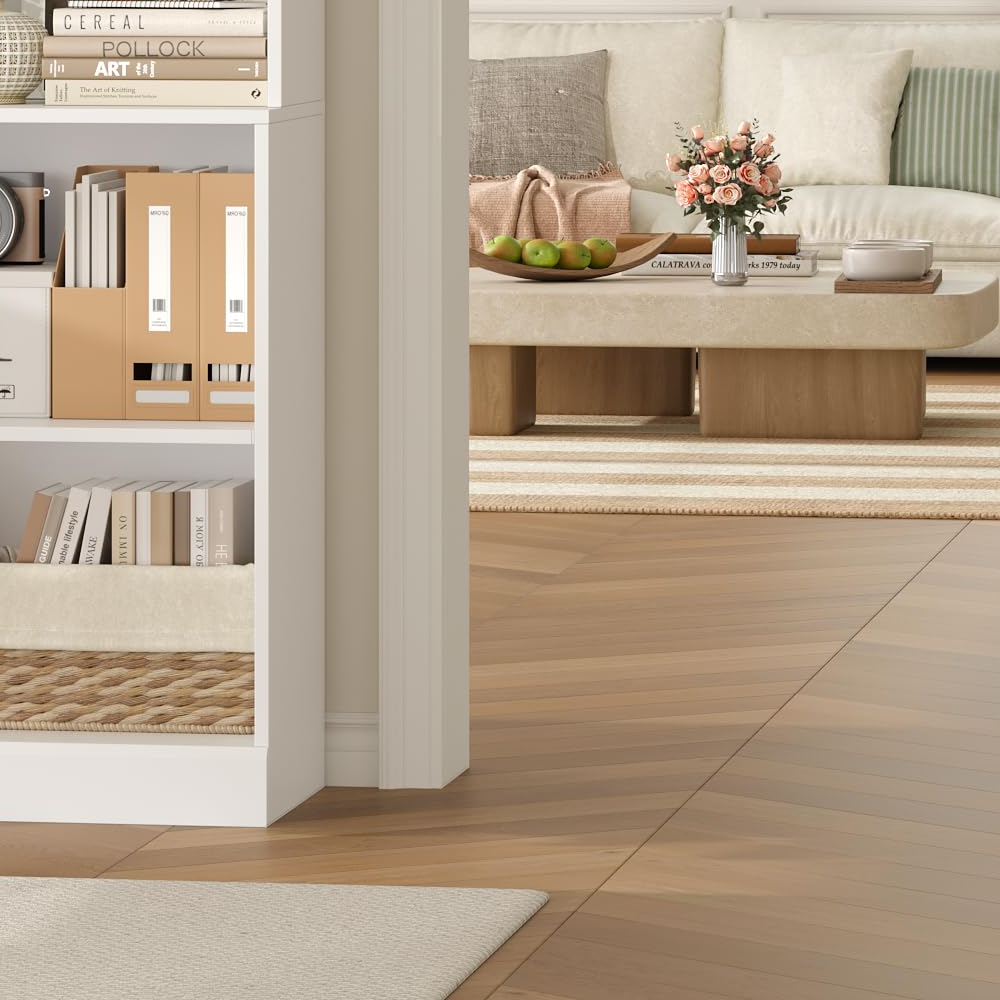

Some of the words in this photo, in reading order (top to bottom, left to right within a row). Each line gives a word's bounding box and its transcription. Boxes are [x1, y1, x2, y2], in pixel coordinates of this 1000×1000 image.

[63, 14, 146, 31] CEREAL
[102, 40, 206, 58] POLLOCK
[94, 61, 131, 77] ART
[79, 86, 90, 94] The
[91, 86, 103, 94] Art
[103, 86, 111, 94] of
[111, 86, 136, 95] Knitting
[651, 261, 701, 269] CALATRAVA
[761, 260, 778, 269] 1979
[779, 260, 801, 271] today
[63, 509, 79, 542] lifestyle
[118, 515, 128, 531] ON
[195, 525, 204, 551] МОГУ
[39, 535, 53, 563] GUIDE
[84, 535, 98, 565] WAKE
